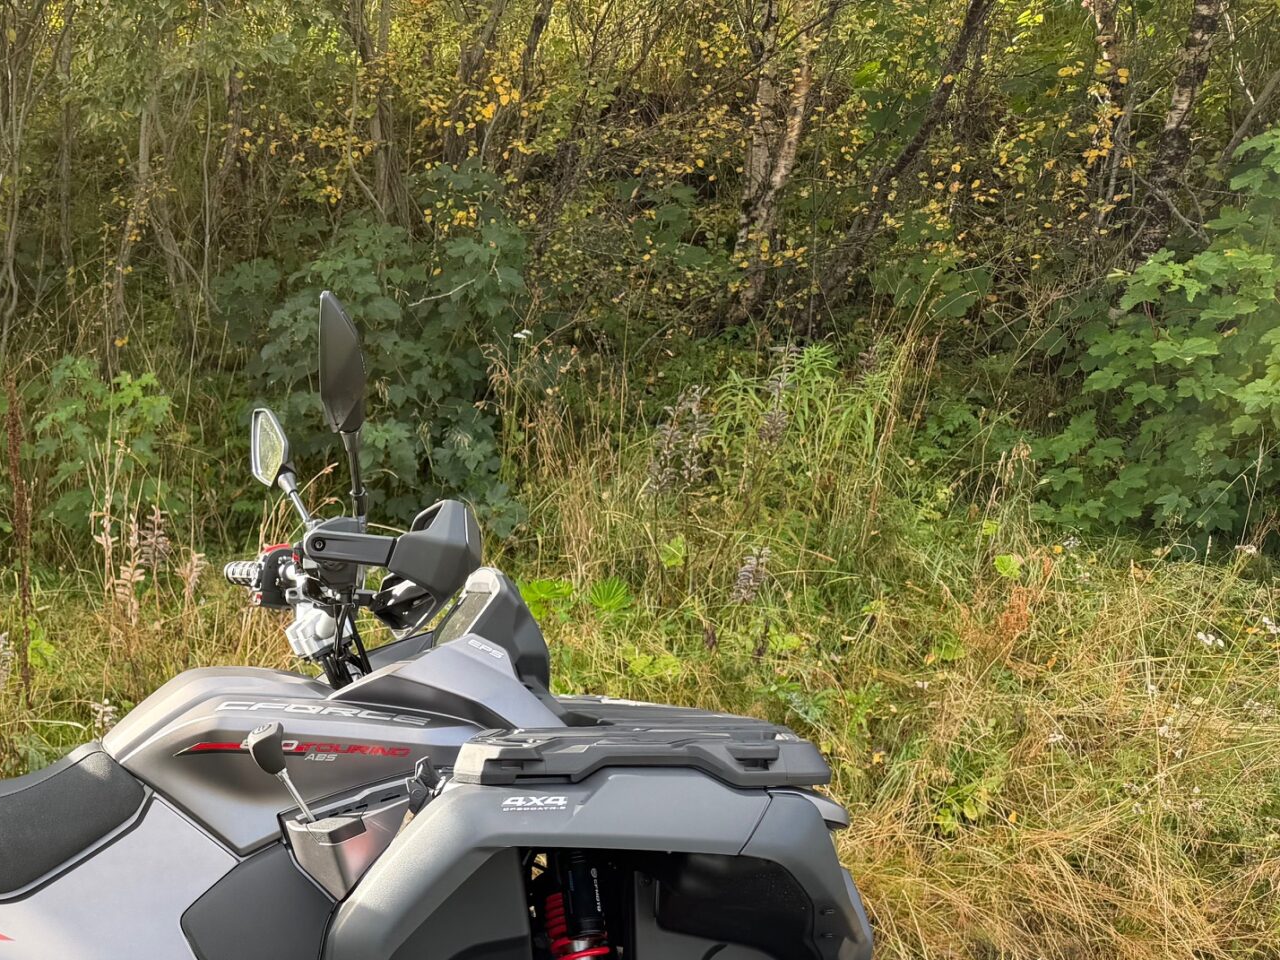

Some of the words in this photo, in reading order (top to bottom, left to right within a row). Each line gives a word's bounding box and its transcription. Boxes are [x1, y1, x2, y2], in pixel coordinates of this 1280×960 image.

[468, 639, 504, 659] EPS
[215, 701, 431, 726] CFORCE
[302, 742, 412, 758] TOURING
[304, 753, 338, 762] ABS
